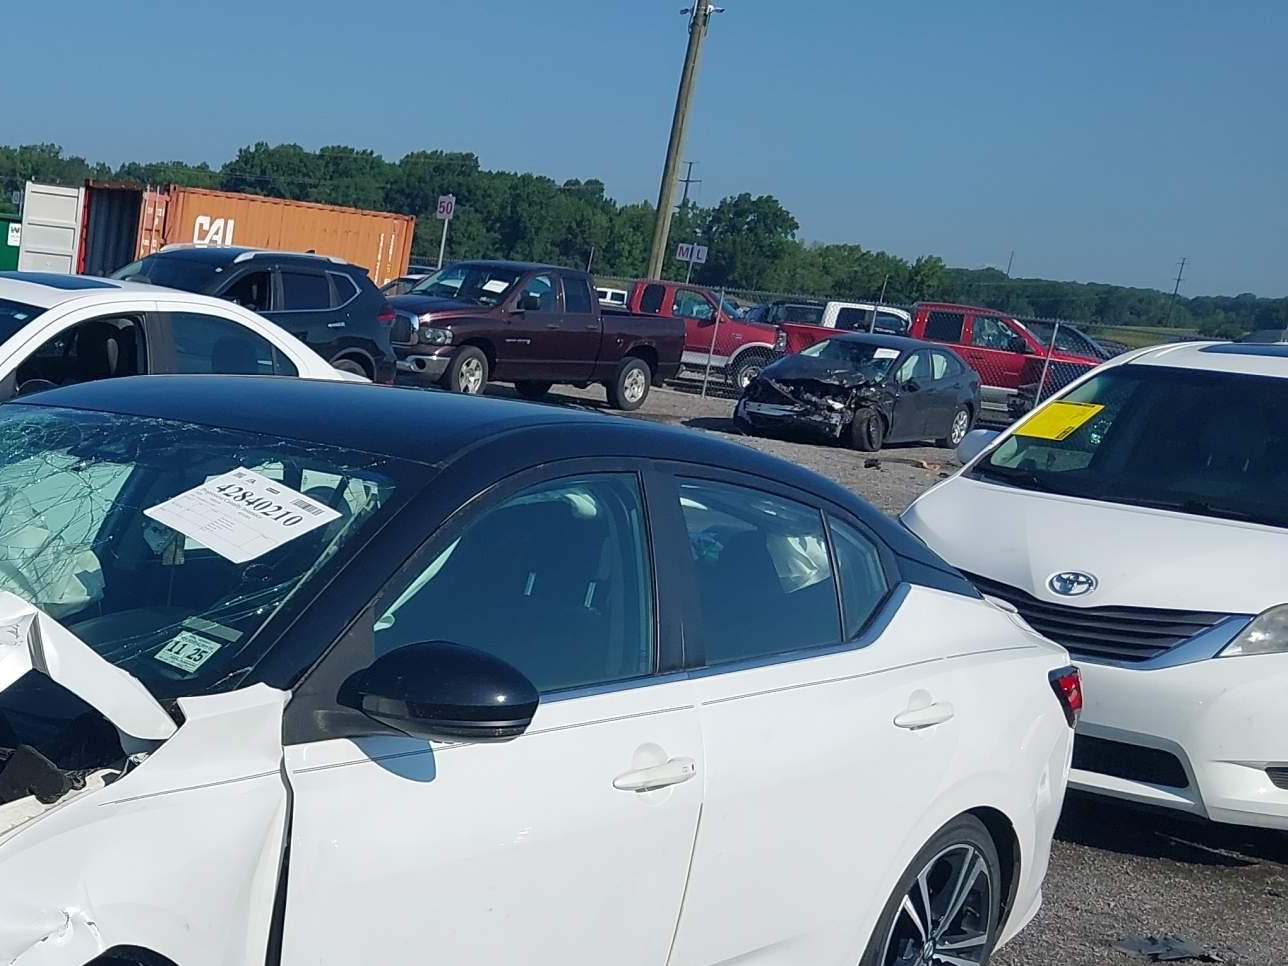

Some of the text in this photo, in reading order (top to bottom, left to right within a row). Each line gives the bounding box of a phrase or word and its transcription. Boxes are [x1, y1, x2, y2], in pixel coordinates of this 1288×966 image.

[439, 201, 453, 215] 50
[216, 483, 304, 527] 42840210
[167, 641, 188, 655] 11
[186, 648, 209, 662] 25
